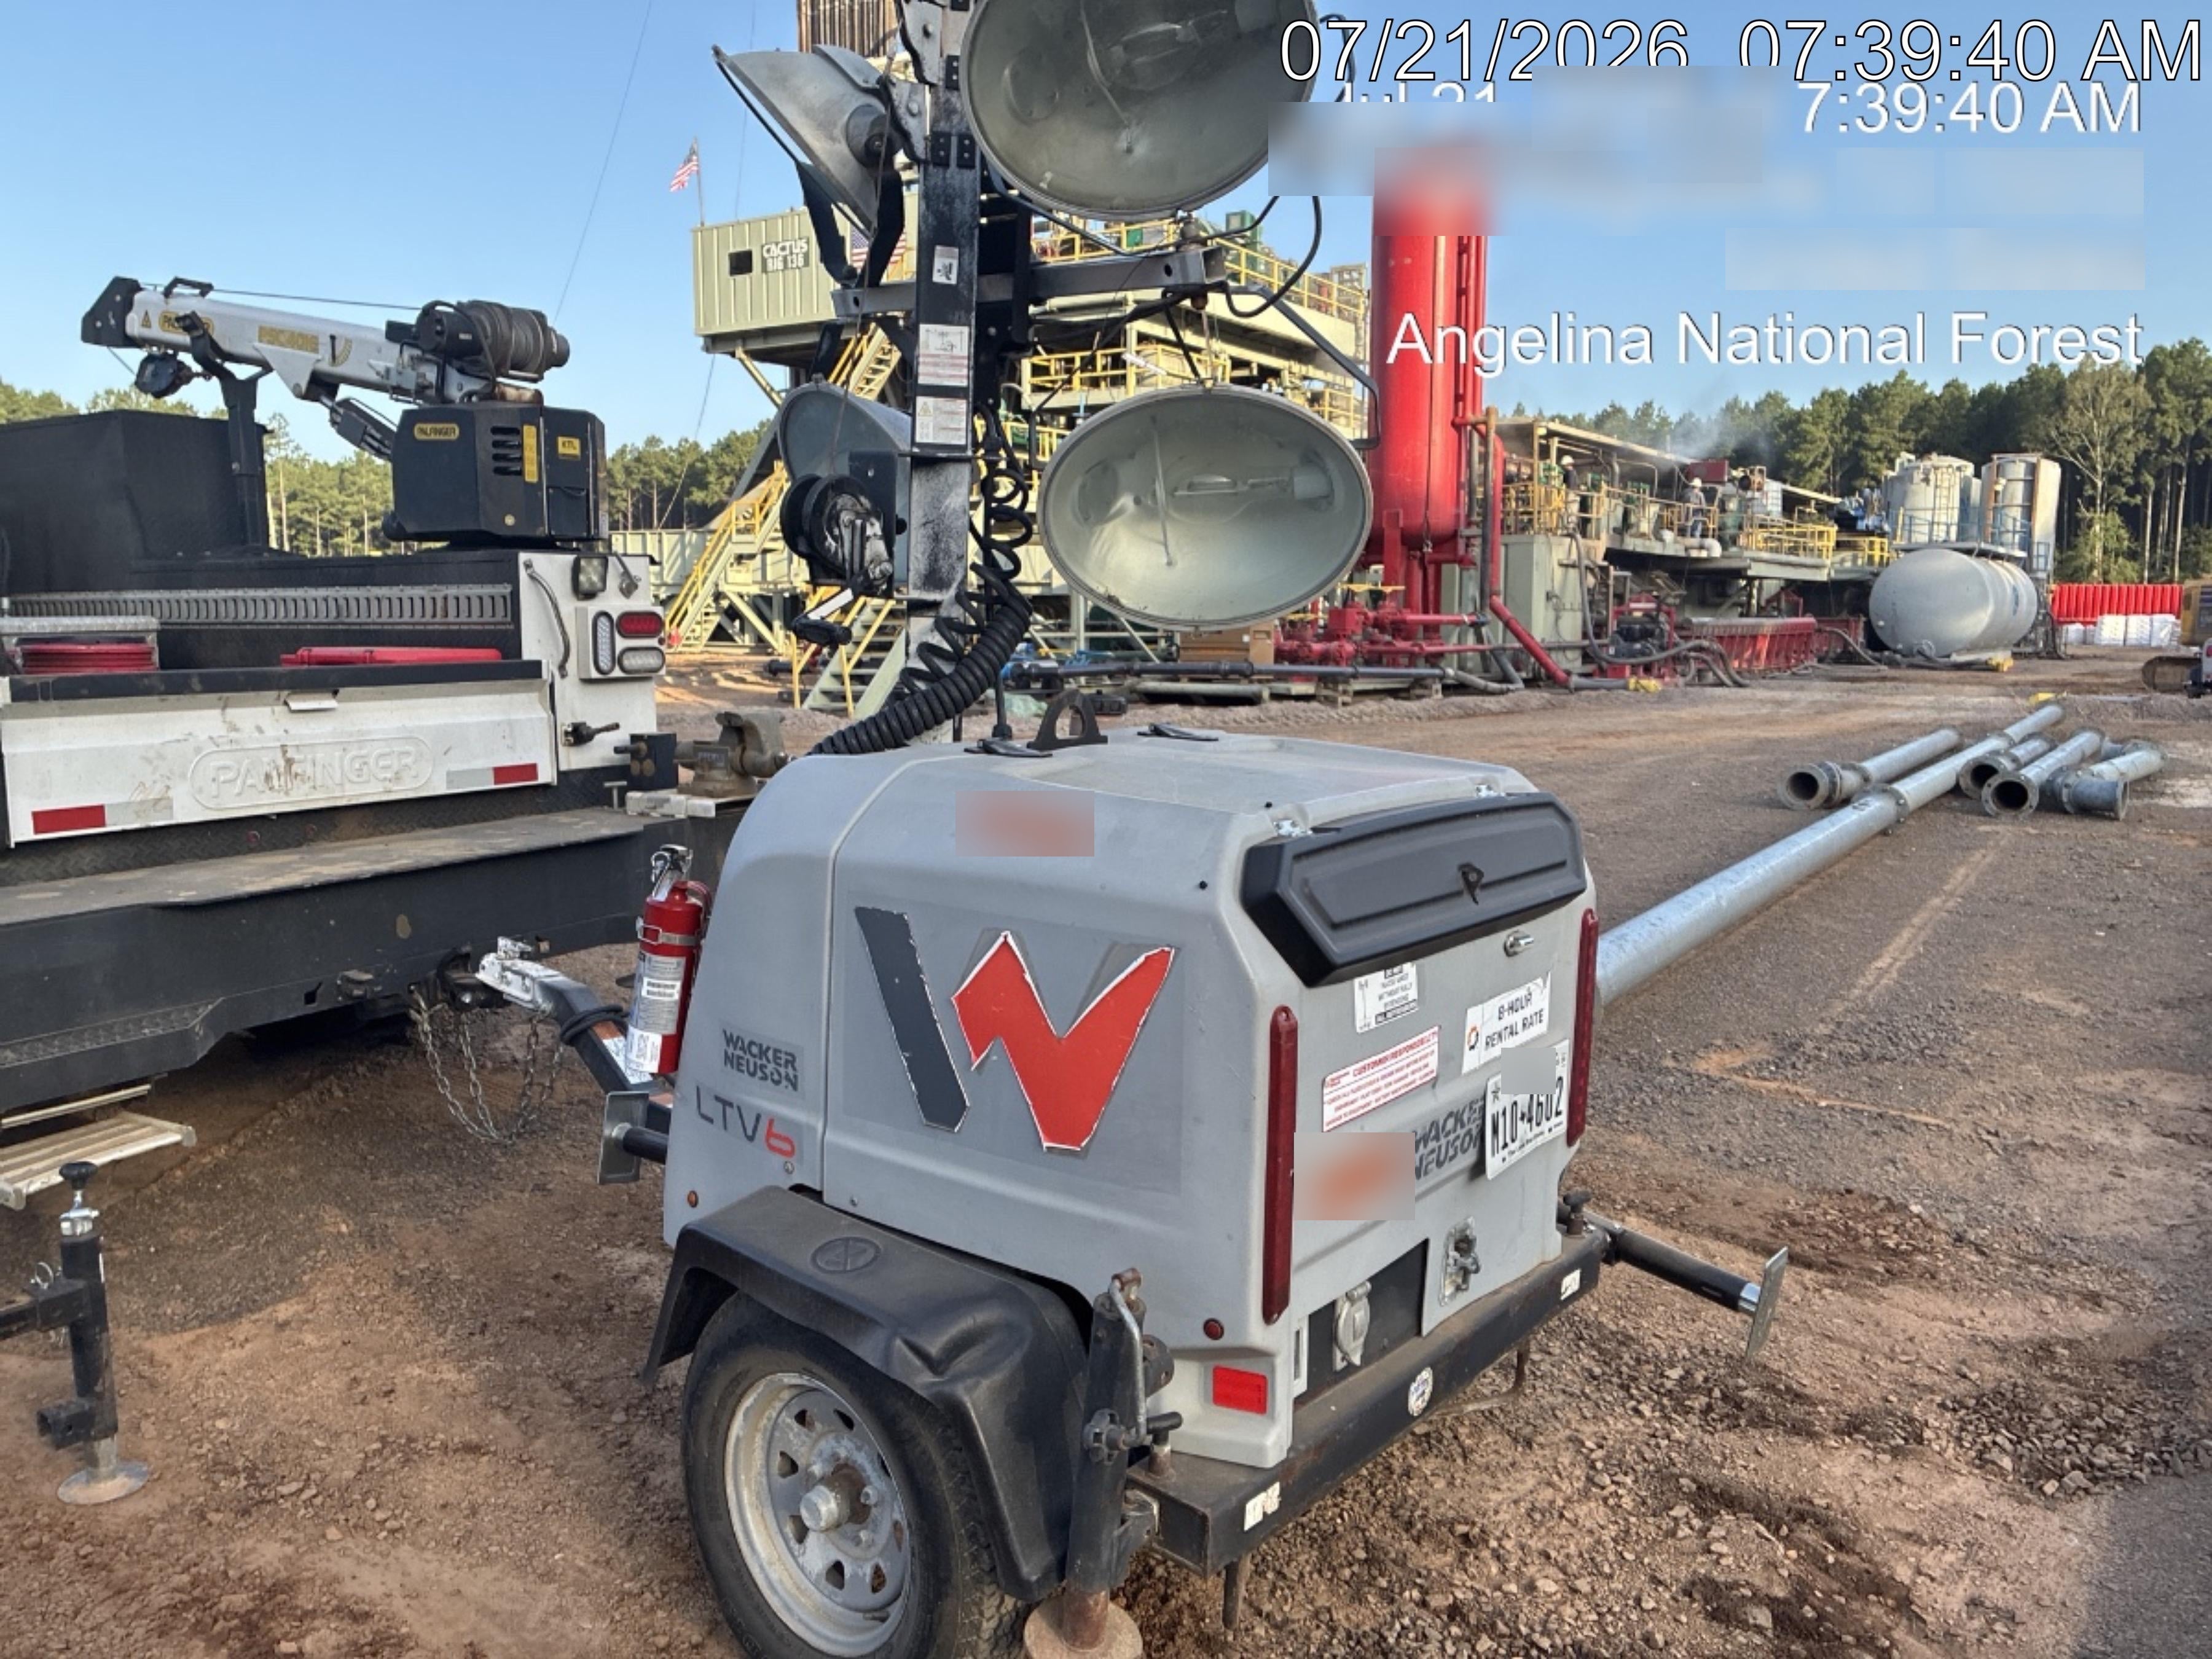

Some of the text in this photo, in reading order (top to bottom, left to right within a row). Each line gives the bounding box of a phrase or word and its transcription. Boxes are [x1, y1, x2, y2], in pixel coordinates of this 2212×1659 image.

[763, 239, 808, 258] CACTUS
[210, 745, 421, 799] PALFINGER
[723, 1028, 798, 1072] WACKER
[1484, 1008, 1543, 1051] RENTAL RATE
[724, 1048, 798, 1092] NEUSON
[696, 1085, 796, 1158] LTV6
